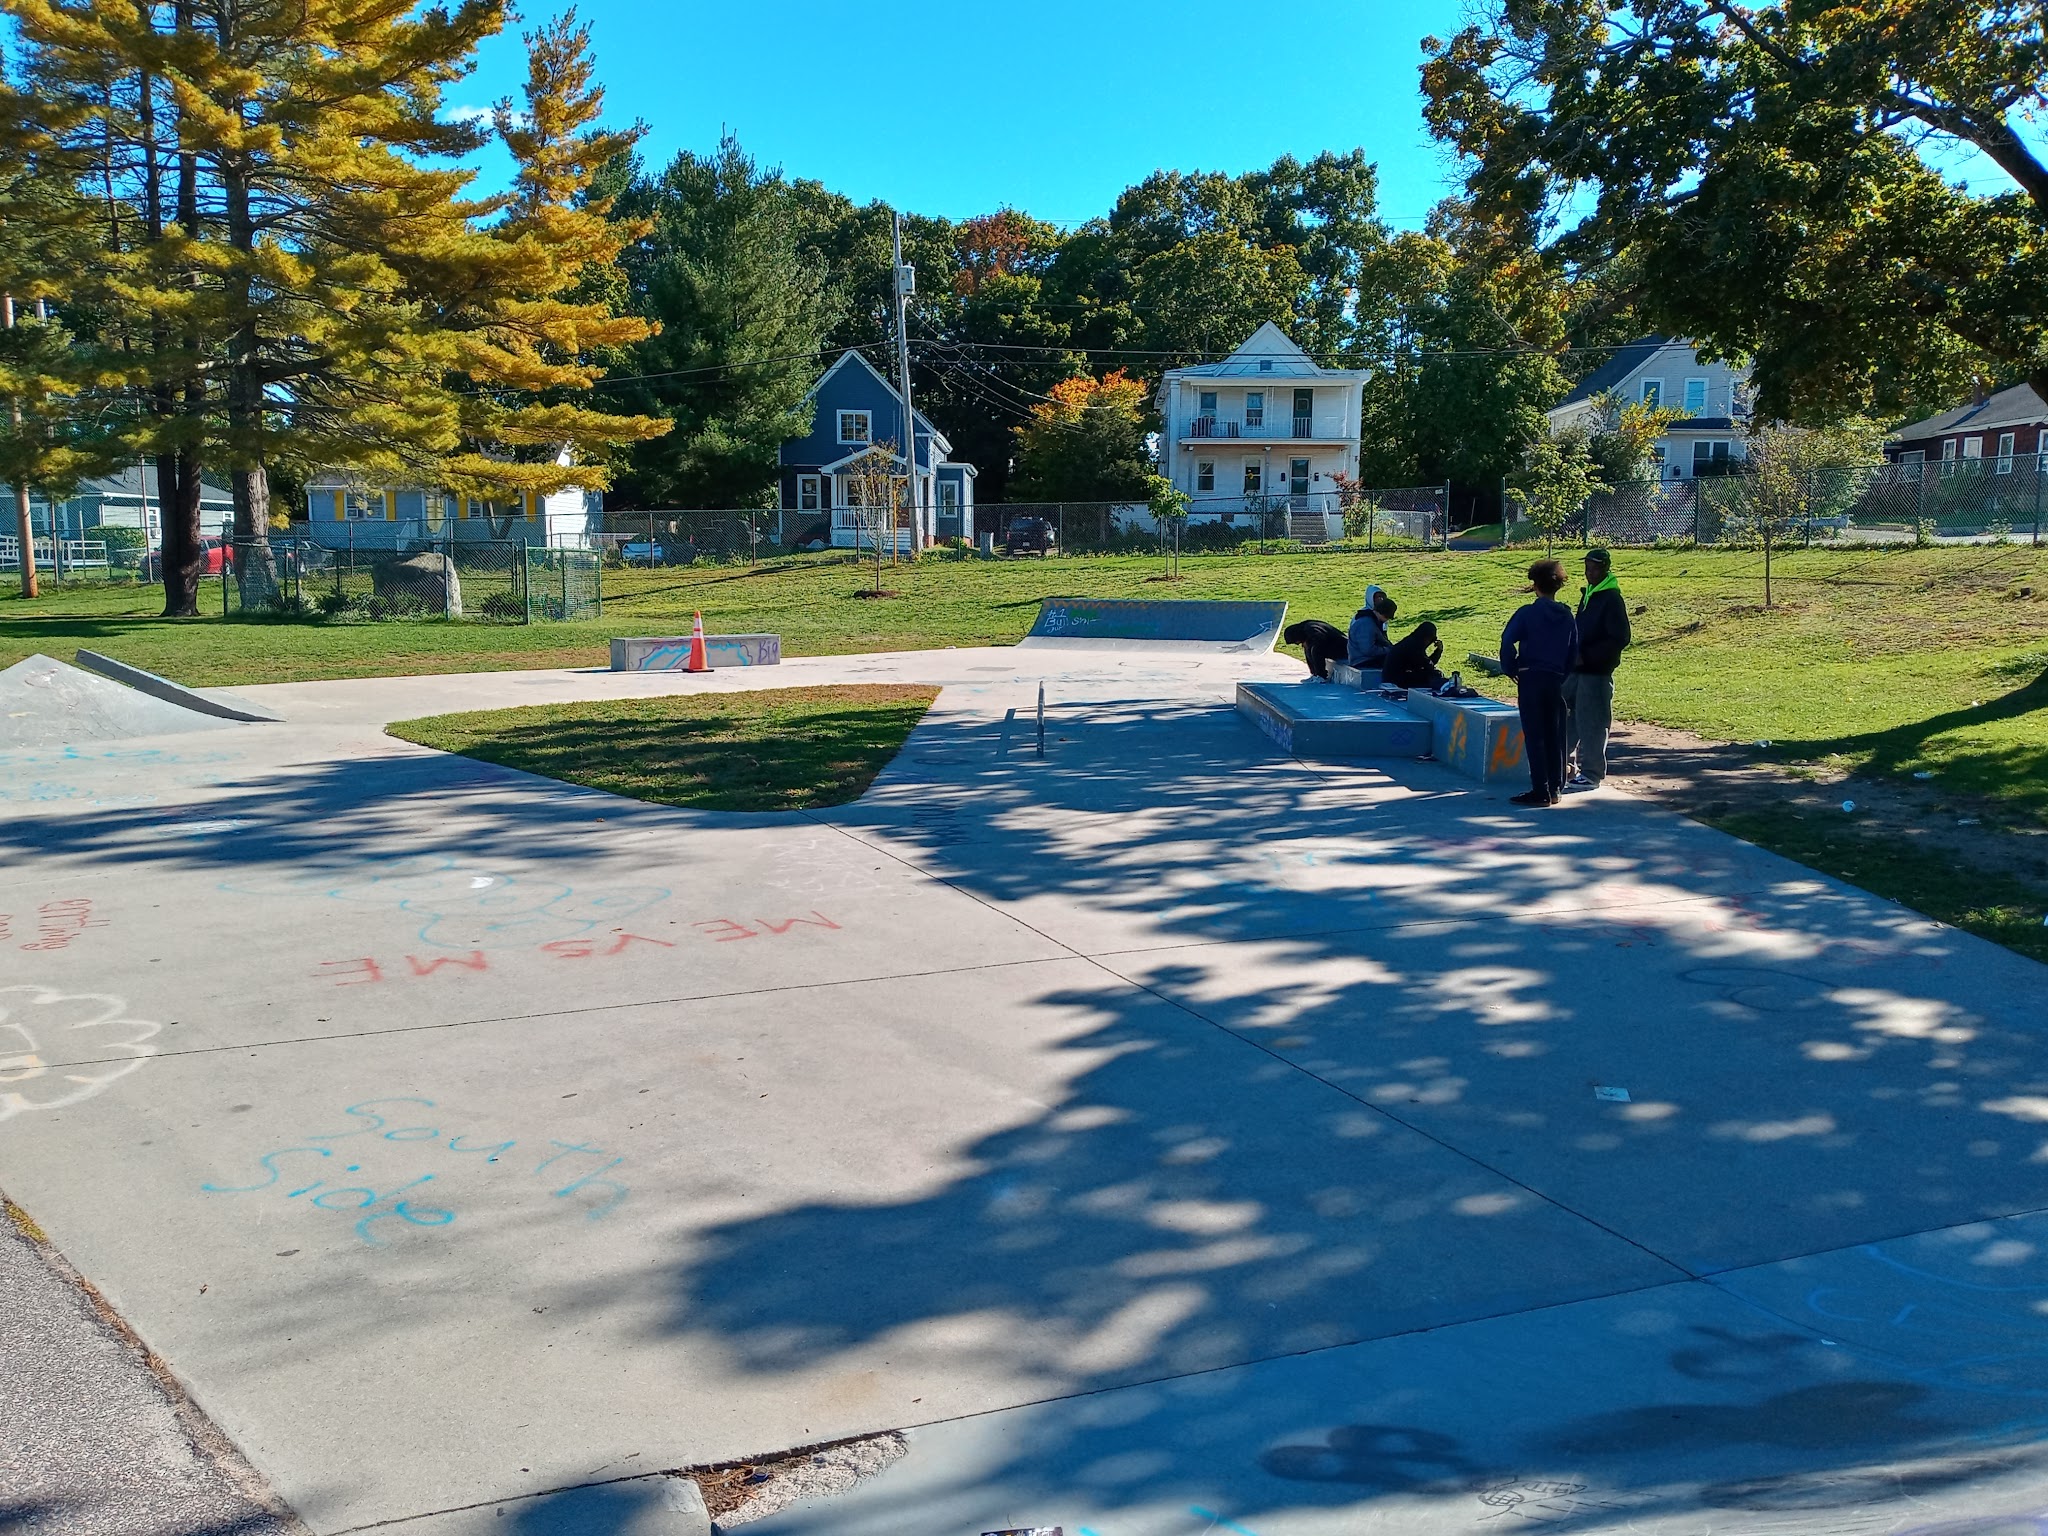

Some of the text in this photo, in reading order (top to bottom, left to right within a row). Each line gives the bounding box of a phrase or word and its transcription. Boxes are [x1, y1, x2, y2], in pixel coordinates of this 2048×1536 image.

[309, 909, 843, 987] ME VS ME
